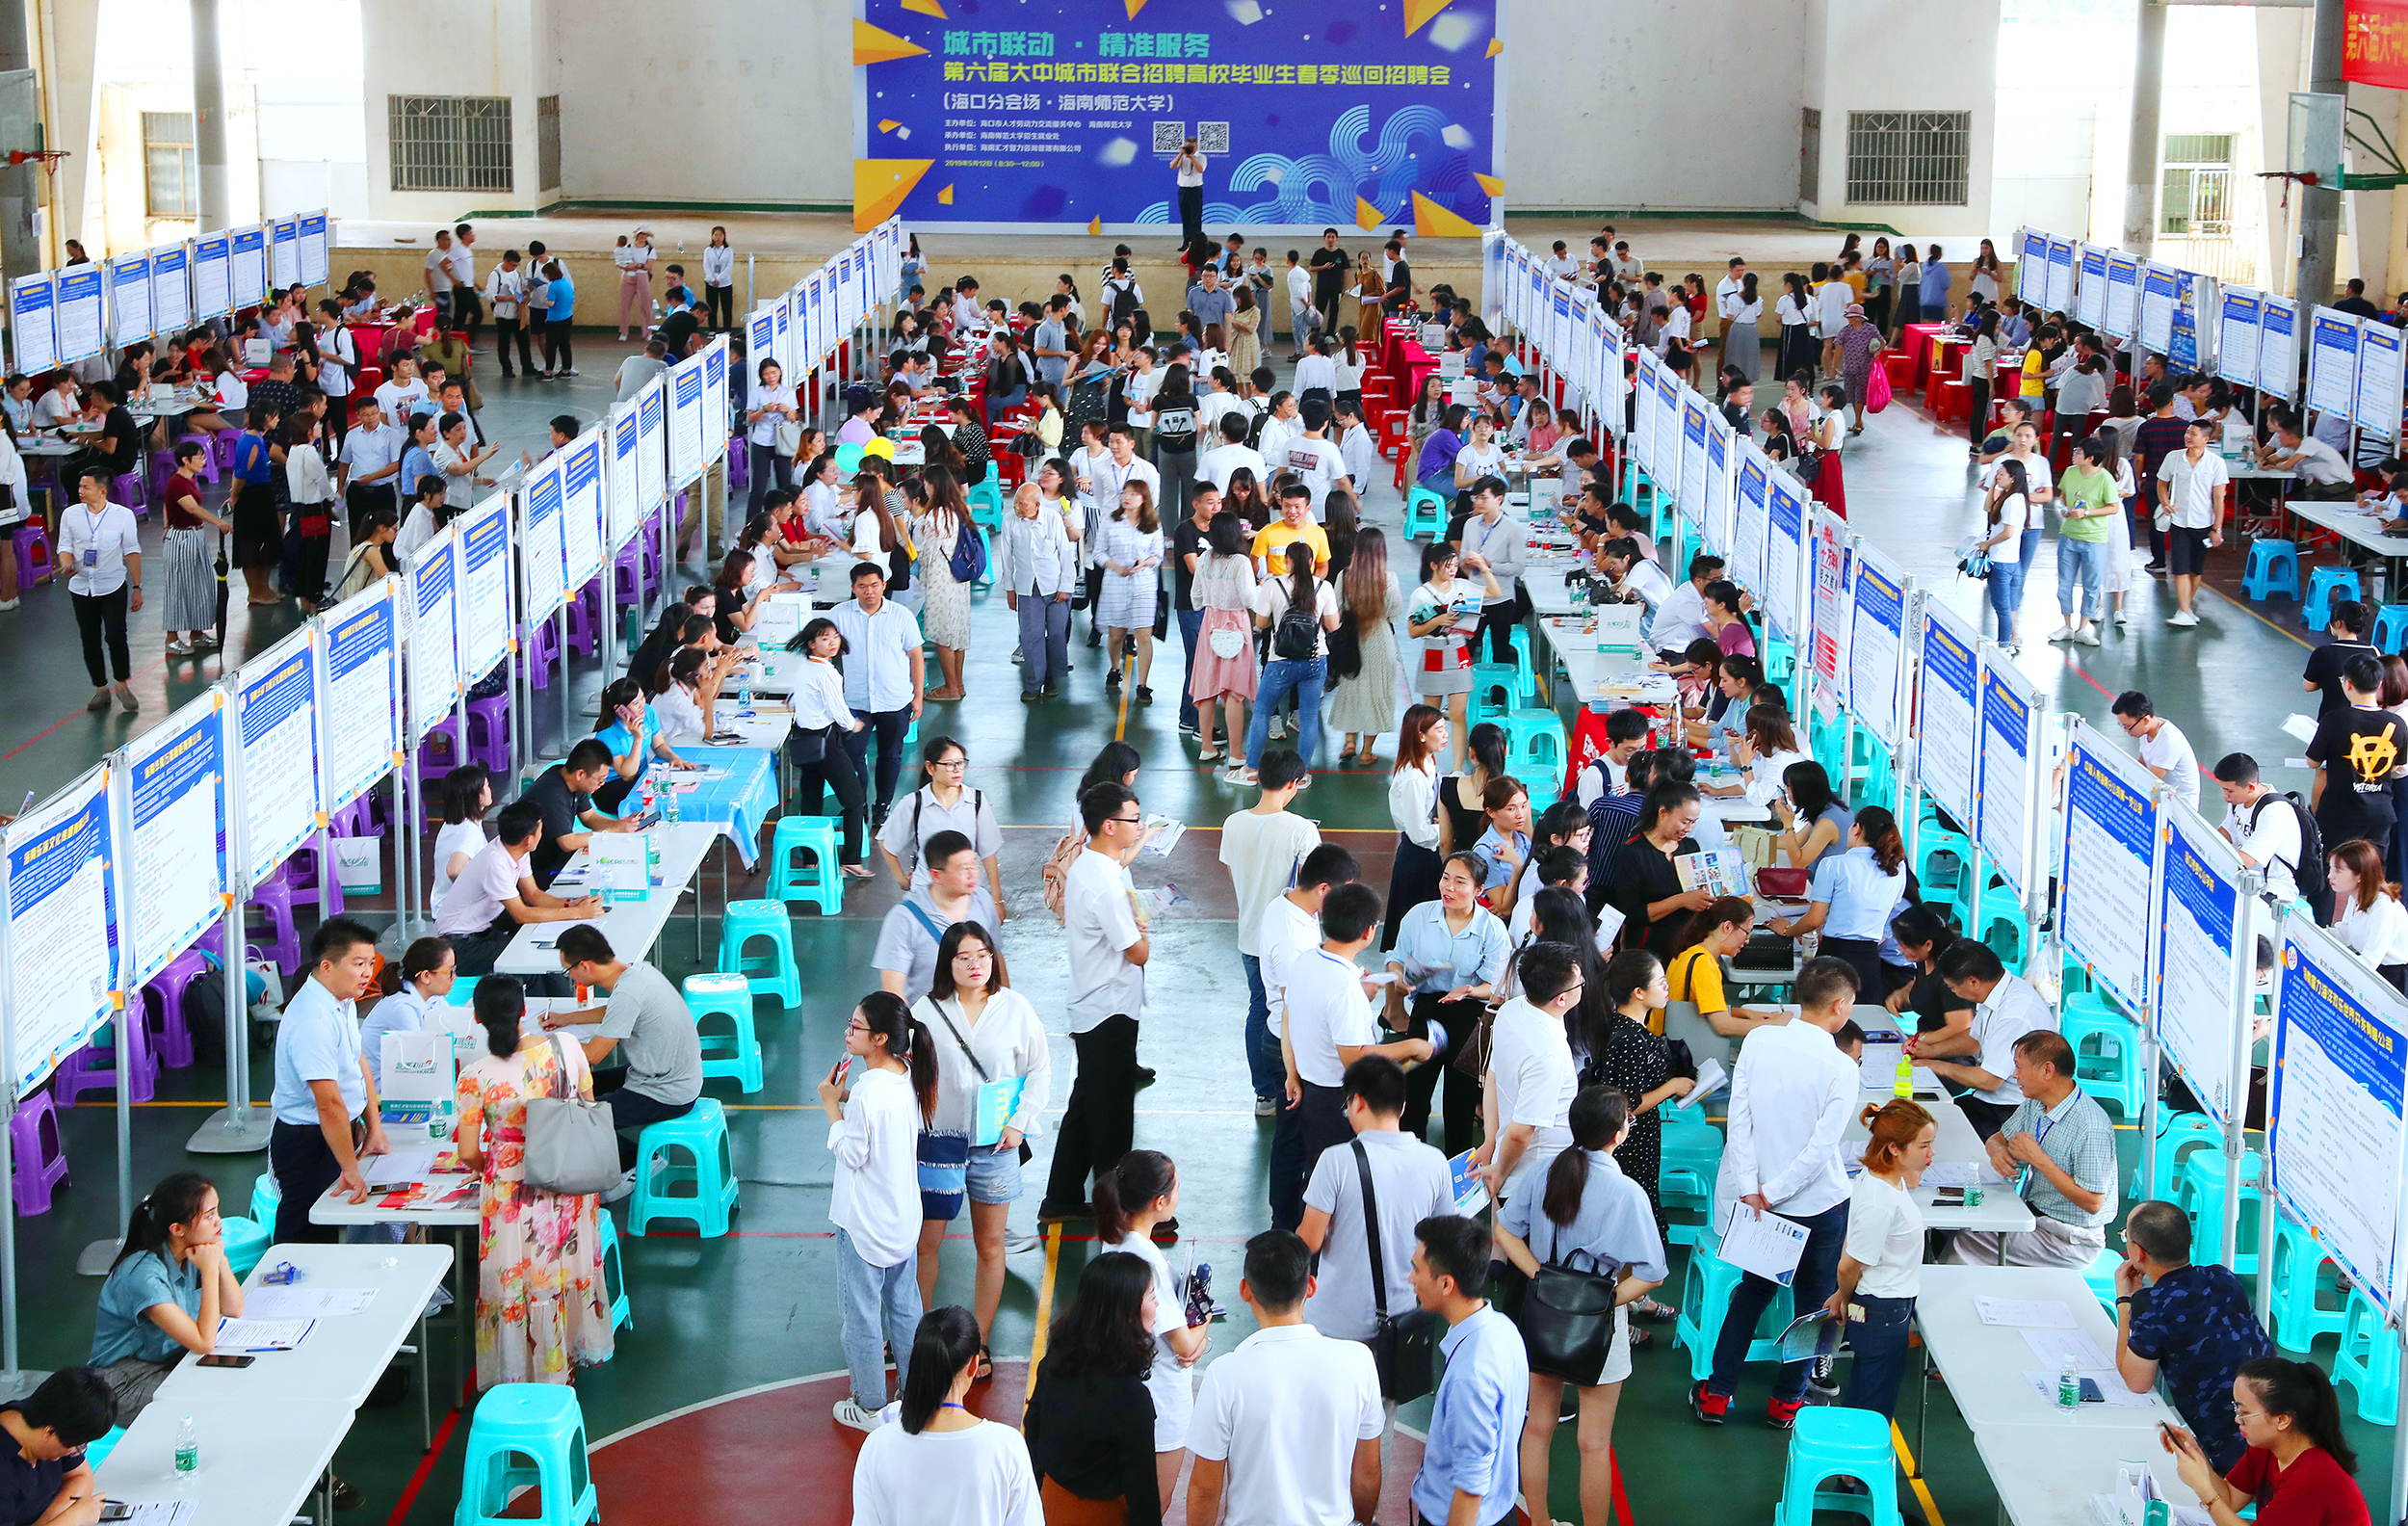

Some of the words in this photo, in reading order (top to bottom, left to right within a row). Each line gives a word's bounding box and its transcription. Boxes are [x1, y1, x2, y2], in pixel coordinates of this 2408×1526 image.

[943, 30, 1055, 57] 城市联动
[1098, 32, 1210, 58] 精准服务
[2345, 11, 2408, 66] 第六届大中
[943, 61, 1451, 86] 第六届大中城市联合招聘高校毕业生春季巡回招聘会
